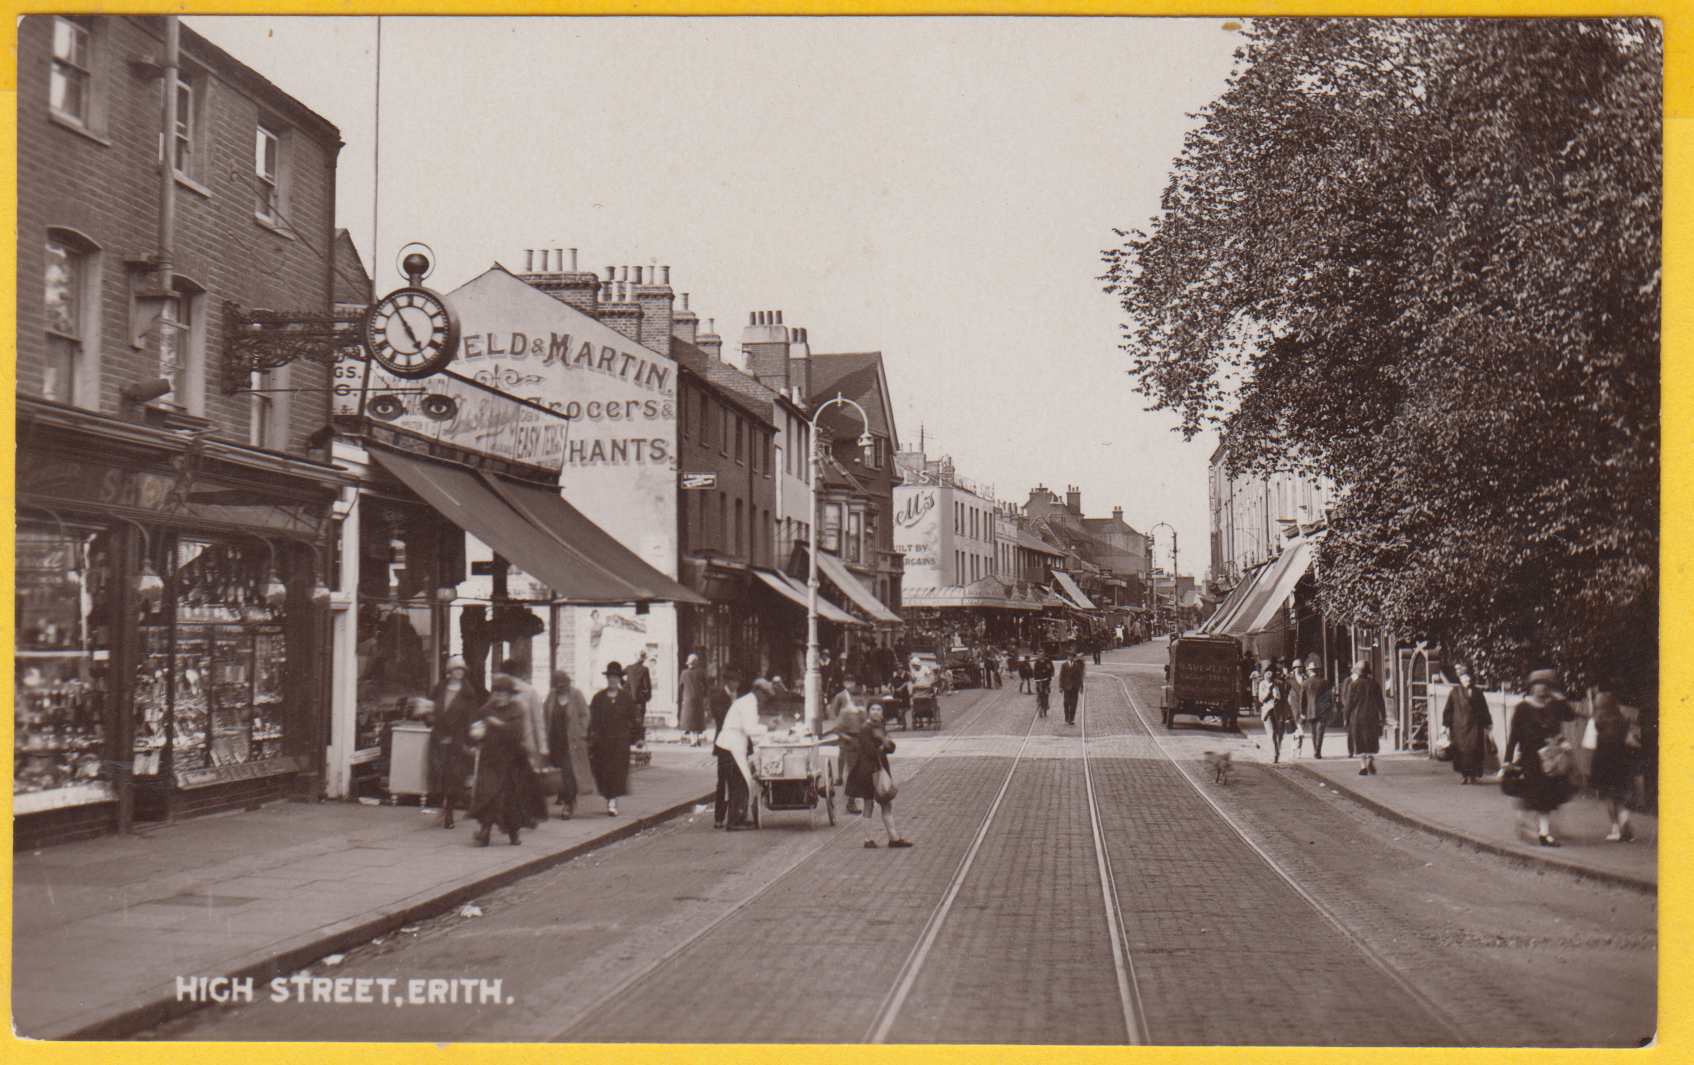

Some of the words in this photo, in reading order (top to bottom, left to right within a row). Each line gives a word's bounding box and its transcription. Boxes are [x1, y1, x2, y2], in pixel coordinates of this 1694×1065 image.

[915, 544, 929, 553] BY
[903, 557, 936, 566] RGAINS
[1178, 662, 1230, 673] WAVERLEY
[1180, 673, 1228, 682] CIGARTTES
